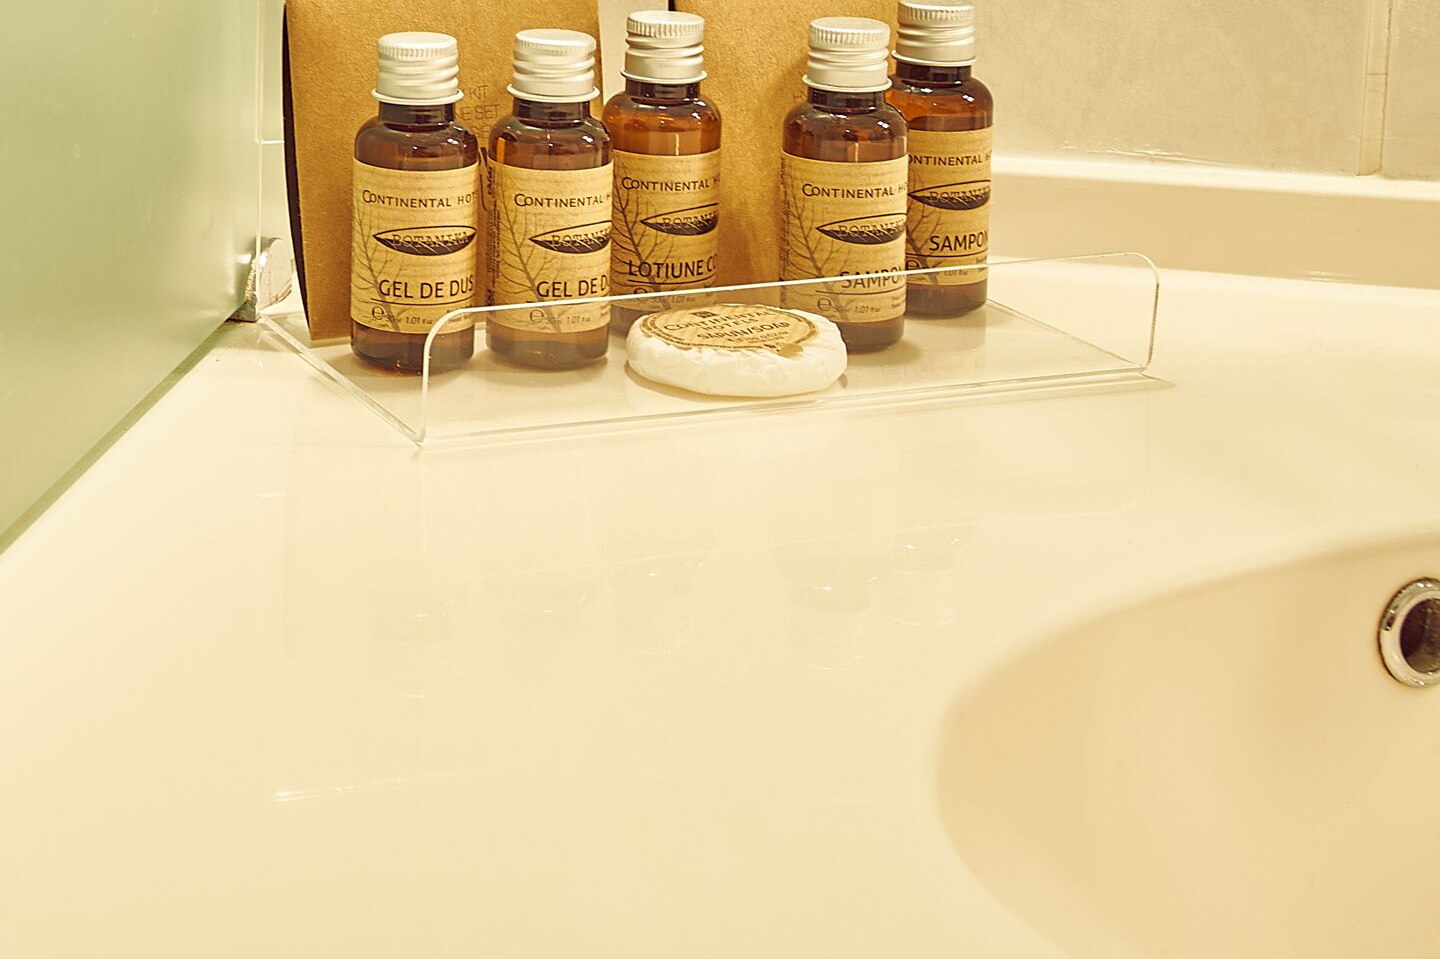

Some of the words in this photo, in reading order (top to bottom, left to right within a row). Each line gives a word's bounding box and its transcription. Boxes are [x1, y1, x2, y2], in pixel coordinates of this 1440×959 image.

[908, 154, 982, 166] ONTINENTAL
[621, 176, 710, 191] CONTINENTAL
[802, 183, 894, 199] CONTINENTAL
[362, 189, 452, 208] CONTINENTAL
[514, 193, 604, 208] CONTINENTAL
[627, 259, 704, 279] LOTIUNE
[379, 279, 413, 298] GEL
[420, 281, 444, 299] DE
[450, 275, 474, 297] DUS
[536, 281, 572, 298] GEL
[578, 278, 598, 297] DE
[664, 311, 776, 331] CONTINENTAL
[701, 318, 758, 331] HOTELS
[697, 322, 790, 340] SAPUN/SOAP
